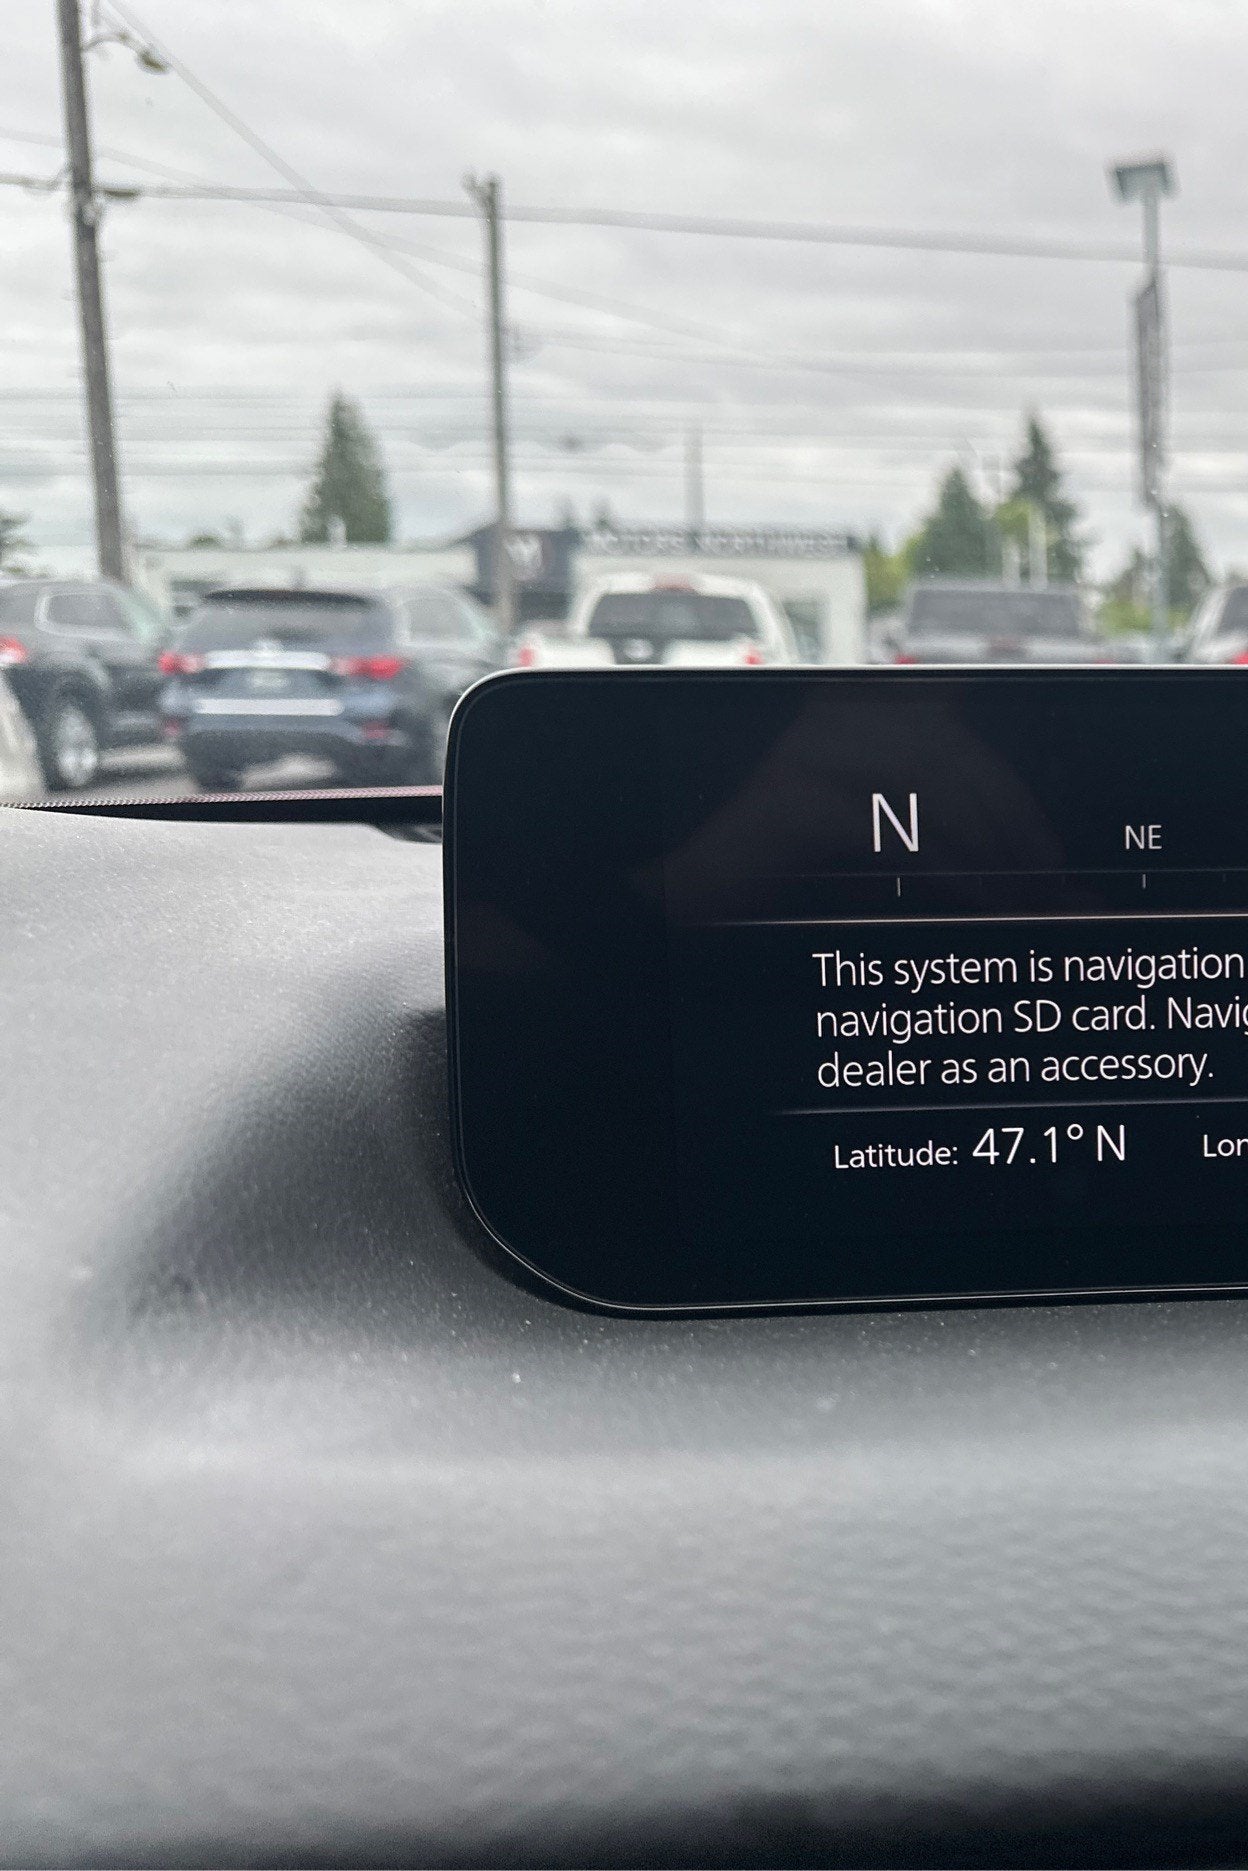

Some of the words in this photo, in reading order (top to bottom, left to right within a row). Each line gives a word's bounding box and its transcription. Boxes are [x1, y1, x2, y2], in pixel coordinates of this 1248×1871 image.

[871, 792, 919, 853] N
[1125, 824, 1163, 850] NE
[811, 949, 884, 987] This
[894, 953, 1018, 994] system
[1029, 949, 1054, 983] is
[1064, 946, 1245, 989] navigation
[816, 1001, 1003, 1045] navigation
[1013, 999, 1062, 1033] SD
[1071, 994, 1156, 1032] card.
[817, 1049, 932, 1088] dealer
[940, 1058, 978, 1085] as
[987, 1057, 1030, 1083] an
[1040, 1053, 1214, 1087] accessory.
[834, 1139, 958, 1169] Latitude:
